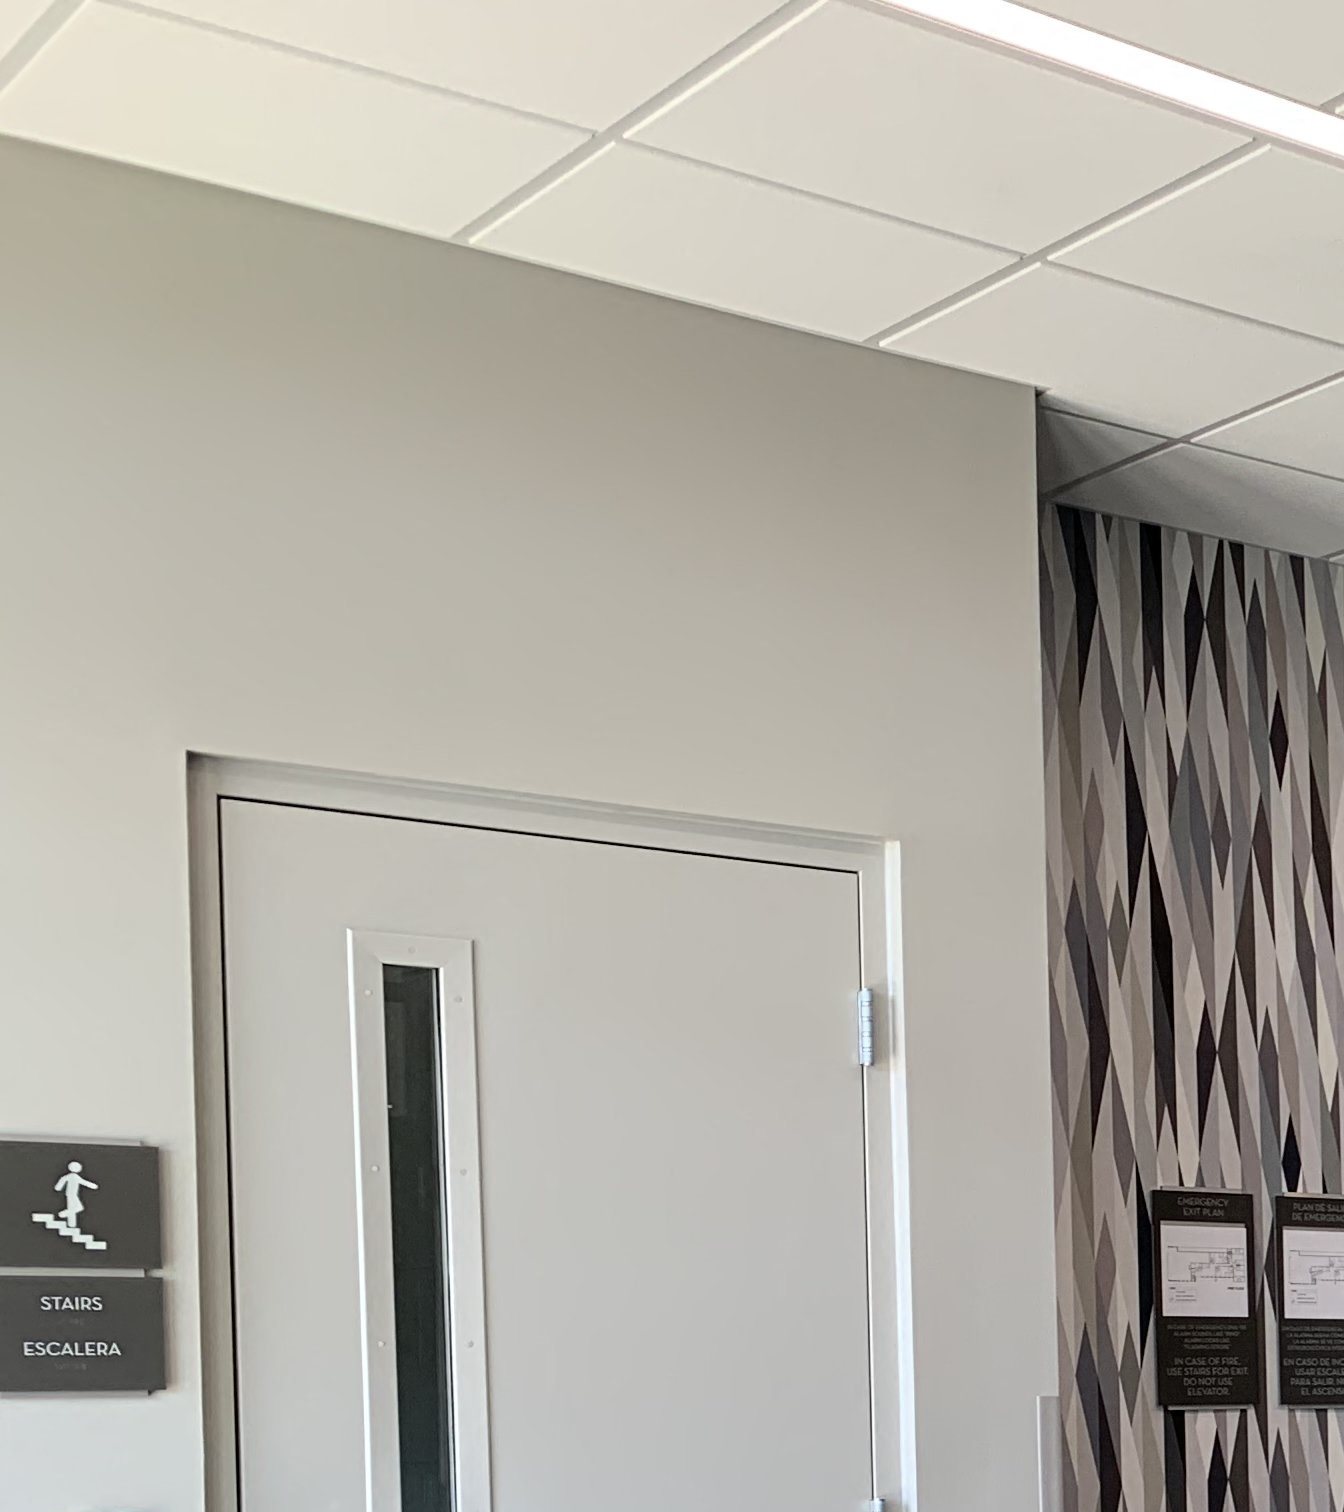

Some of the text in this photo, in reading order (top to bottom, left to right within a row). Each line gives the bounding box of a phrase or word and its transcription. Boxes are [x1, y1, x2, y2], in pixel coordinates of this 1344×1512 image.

[1177, 1197, 1228, 1207] EMERGENCY
[1183, 1207, 1224, 1216] EXIT PLAN
[40, 1297, 103, 1311] STAIRS
[23, 1342, 121, 1357] ESCALERA
[1174, 1357, 1183, 1365] IN
[1184, 1357, 1207, 1365] CASE
[1208, 1357, 1220, 1365] OF
[1283, 1358, 1294, 1366] EN
[1296, 1358, 1318, 1366] CASO
[1320, 1358, 1330, 1366] DE
[1167, 1367, 1183, 1376] USE
[1184, 1367, 1211, 1376] STAIRS
[1212, 1367, 1229, 1375] FOR
[1183, 1377, 1233, 1386] DO NOT USE
[1290, 1377, 1310, 1385] PARA
[1301, 1387, 1311, 1395] EL
